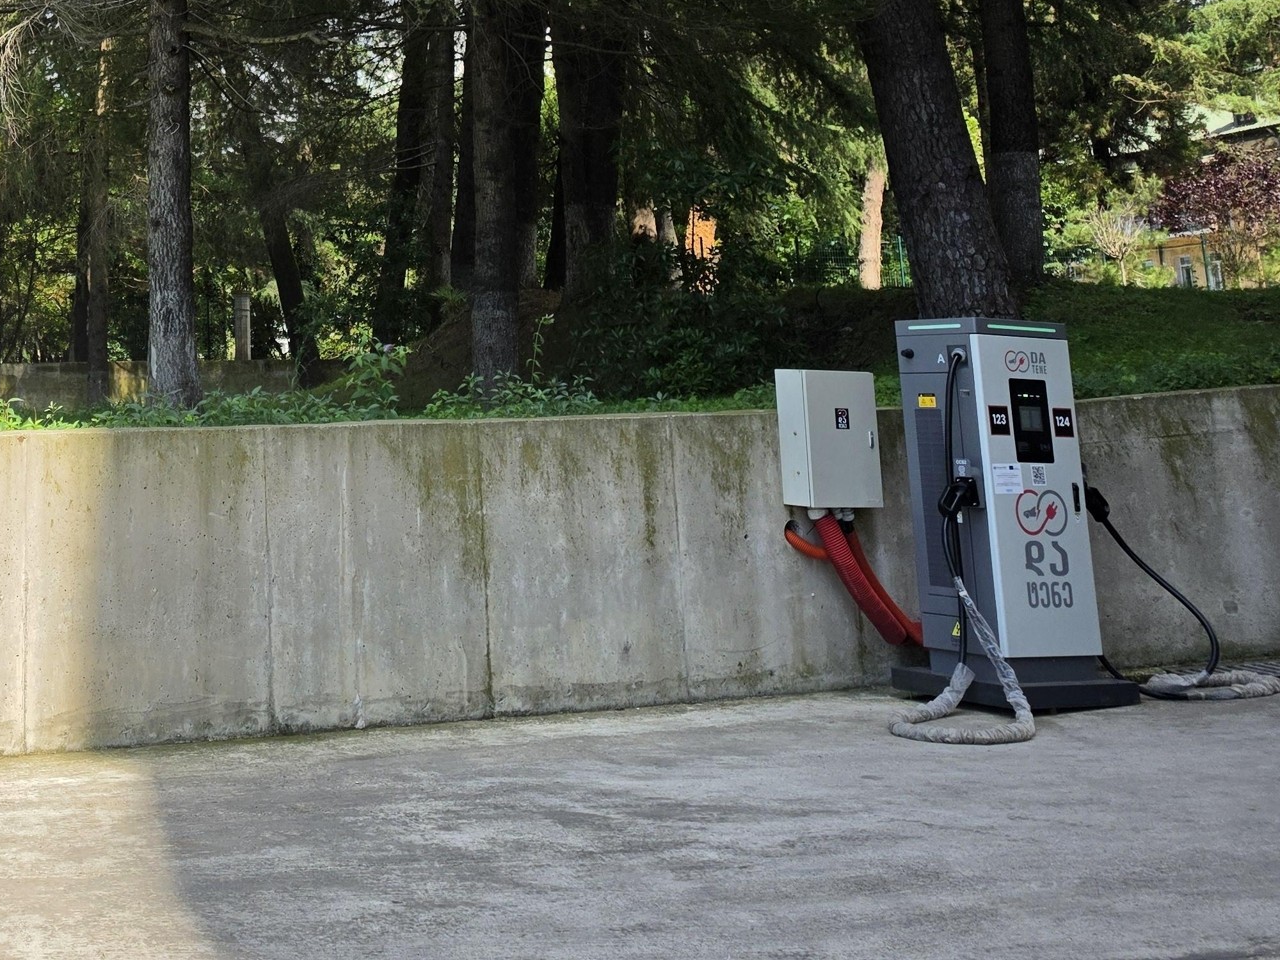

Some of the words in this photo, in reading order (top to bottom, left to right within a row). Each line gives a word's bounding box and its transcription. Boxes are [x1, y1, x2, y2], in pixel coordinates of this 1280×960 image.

[937, 353, 946, 364] A
[1030, 352, 1046, 365] DA
[1031, 365, 1048, 375] TENE
[992, 413, 1007, 425] 123
[1055, 416, 1070, 427] 124
[1025, 540, 1070, 577] და
[1026, 581, 1074, 609] ტენე
